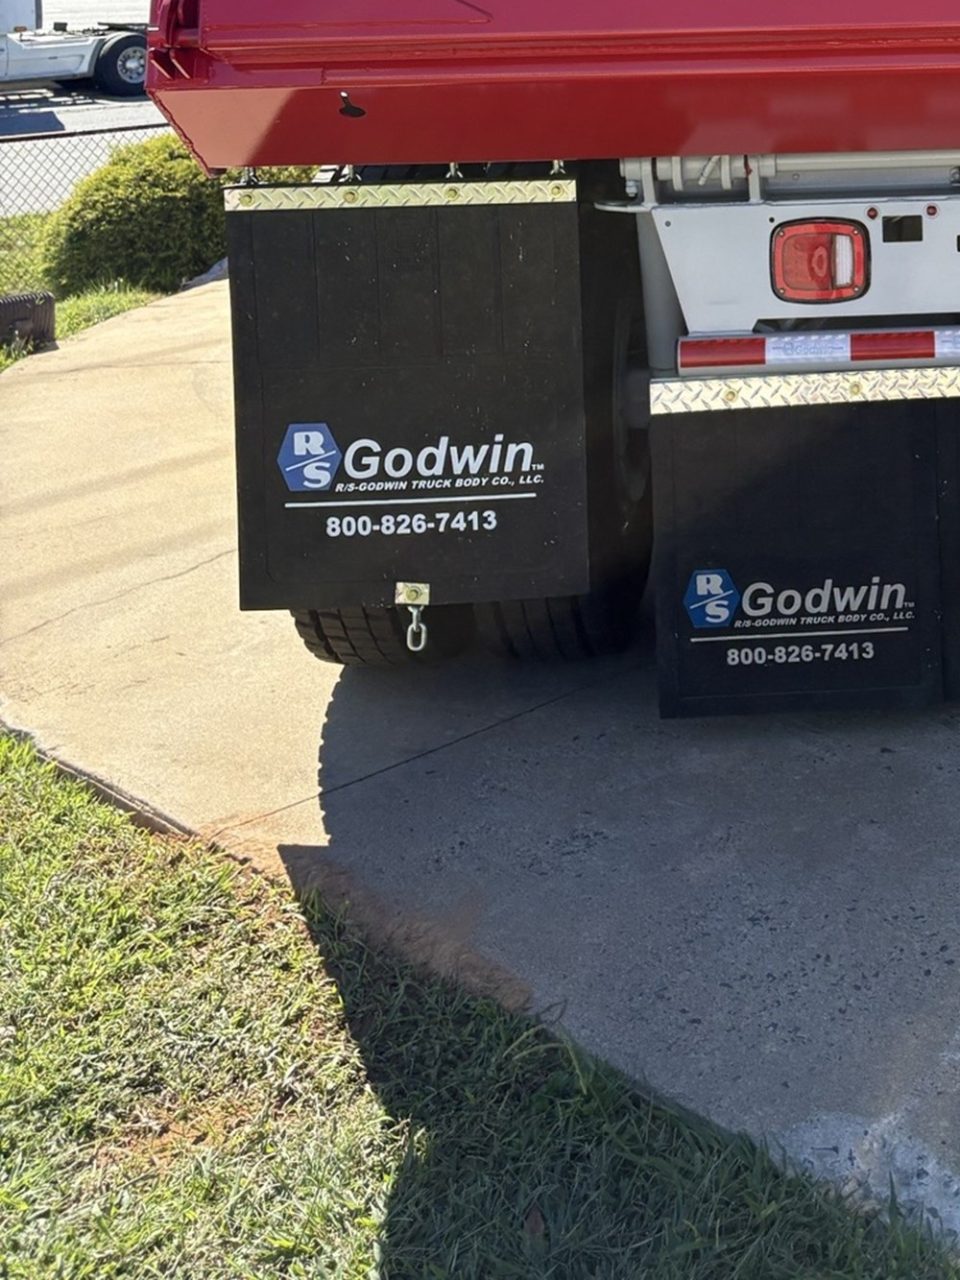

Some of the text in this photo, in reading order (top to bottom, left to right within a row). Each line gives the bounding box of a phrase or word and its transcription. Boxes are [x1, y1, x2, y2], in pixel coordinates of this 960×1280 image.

[344, 433, 533, 479] Godwin
[335, 481, 407, 492] R/S-GODWIN
[411, 479, 452, 489] TRUCK
[455, 477, 488, 488] BODY
[519, 474, 544, 484] LLC.
[326, 510, 497, 537] 800-826-7413
[741, 576, 906, 617] Godwin
[734, 618, 797, 628] R/S-GODWIN
[800, 615, 835, 625] TRUCK
[838, 613, 867, 623] BODY
[727, 642, 874, 666] 800-826-7413
